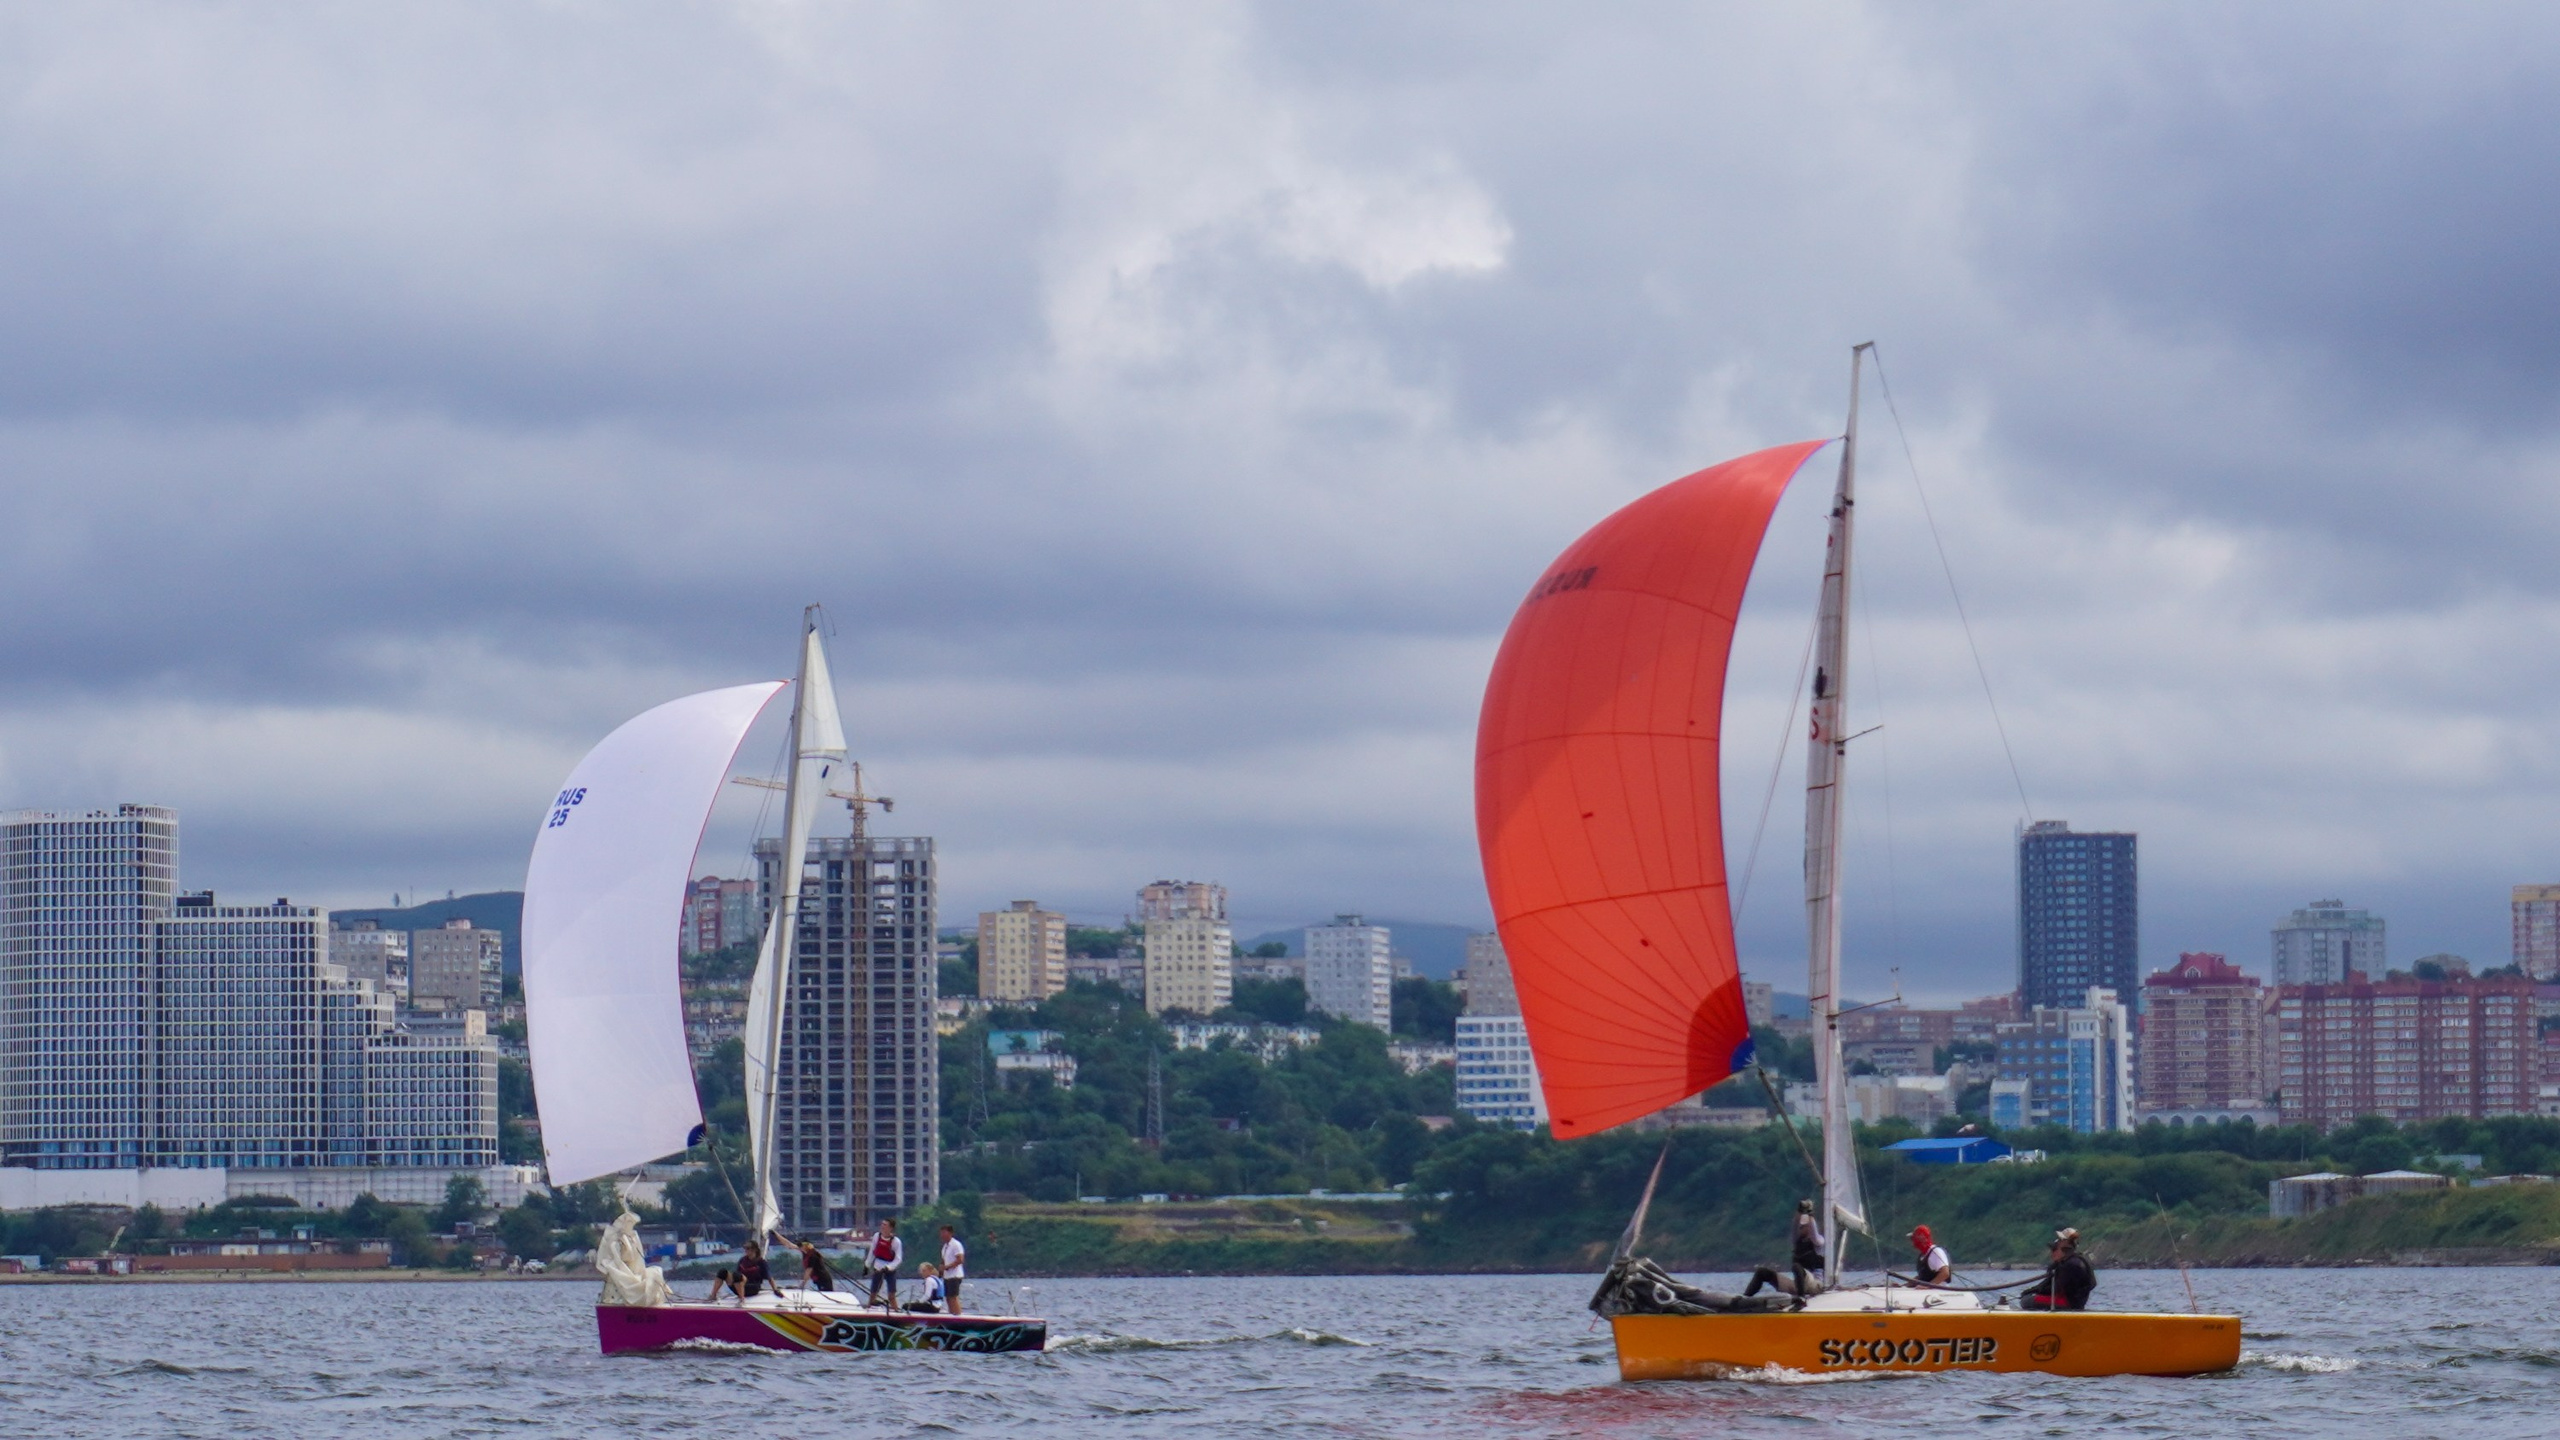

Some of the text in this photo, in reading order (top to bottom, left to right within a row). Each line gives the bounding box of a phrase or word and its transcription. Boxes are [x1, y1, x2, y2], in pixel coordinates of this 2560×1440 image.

[554, 787, 588, 807] RUS
[548, 808, 570, 828] 25
[1819, 1337, 1999, 1366] SCOOTER
